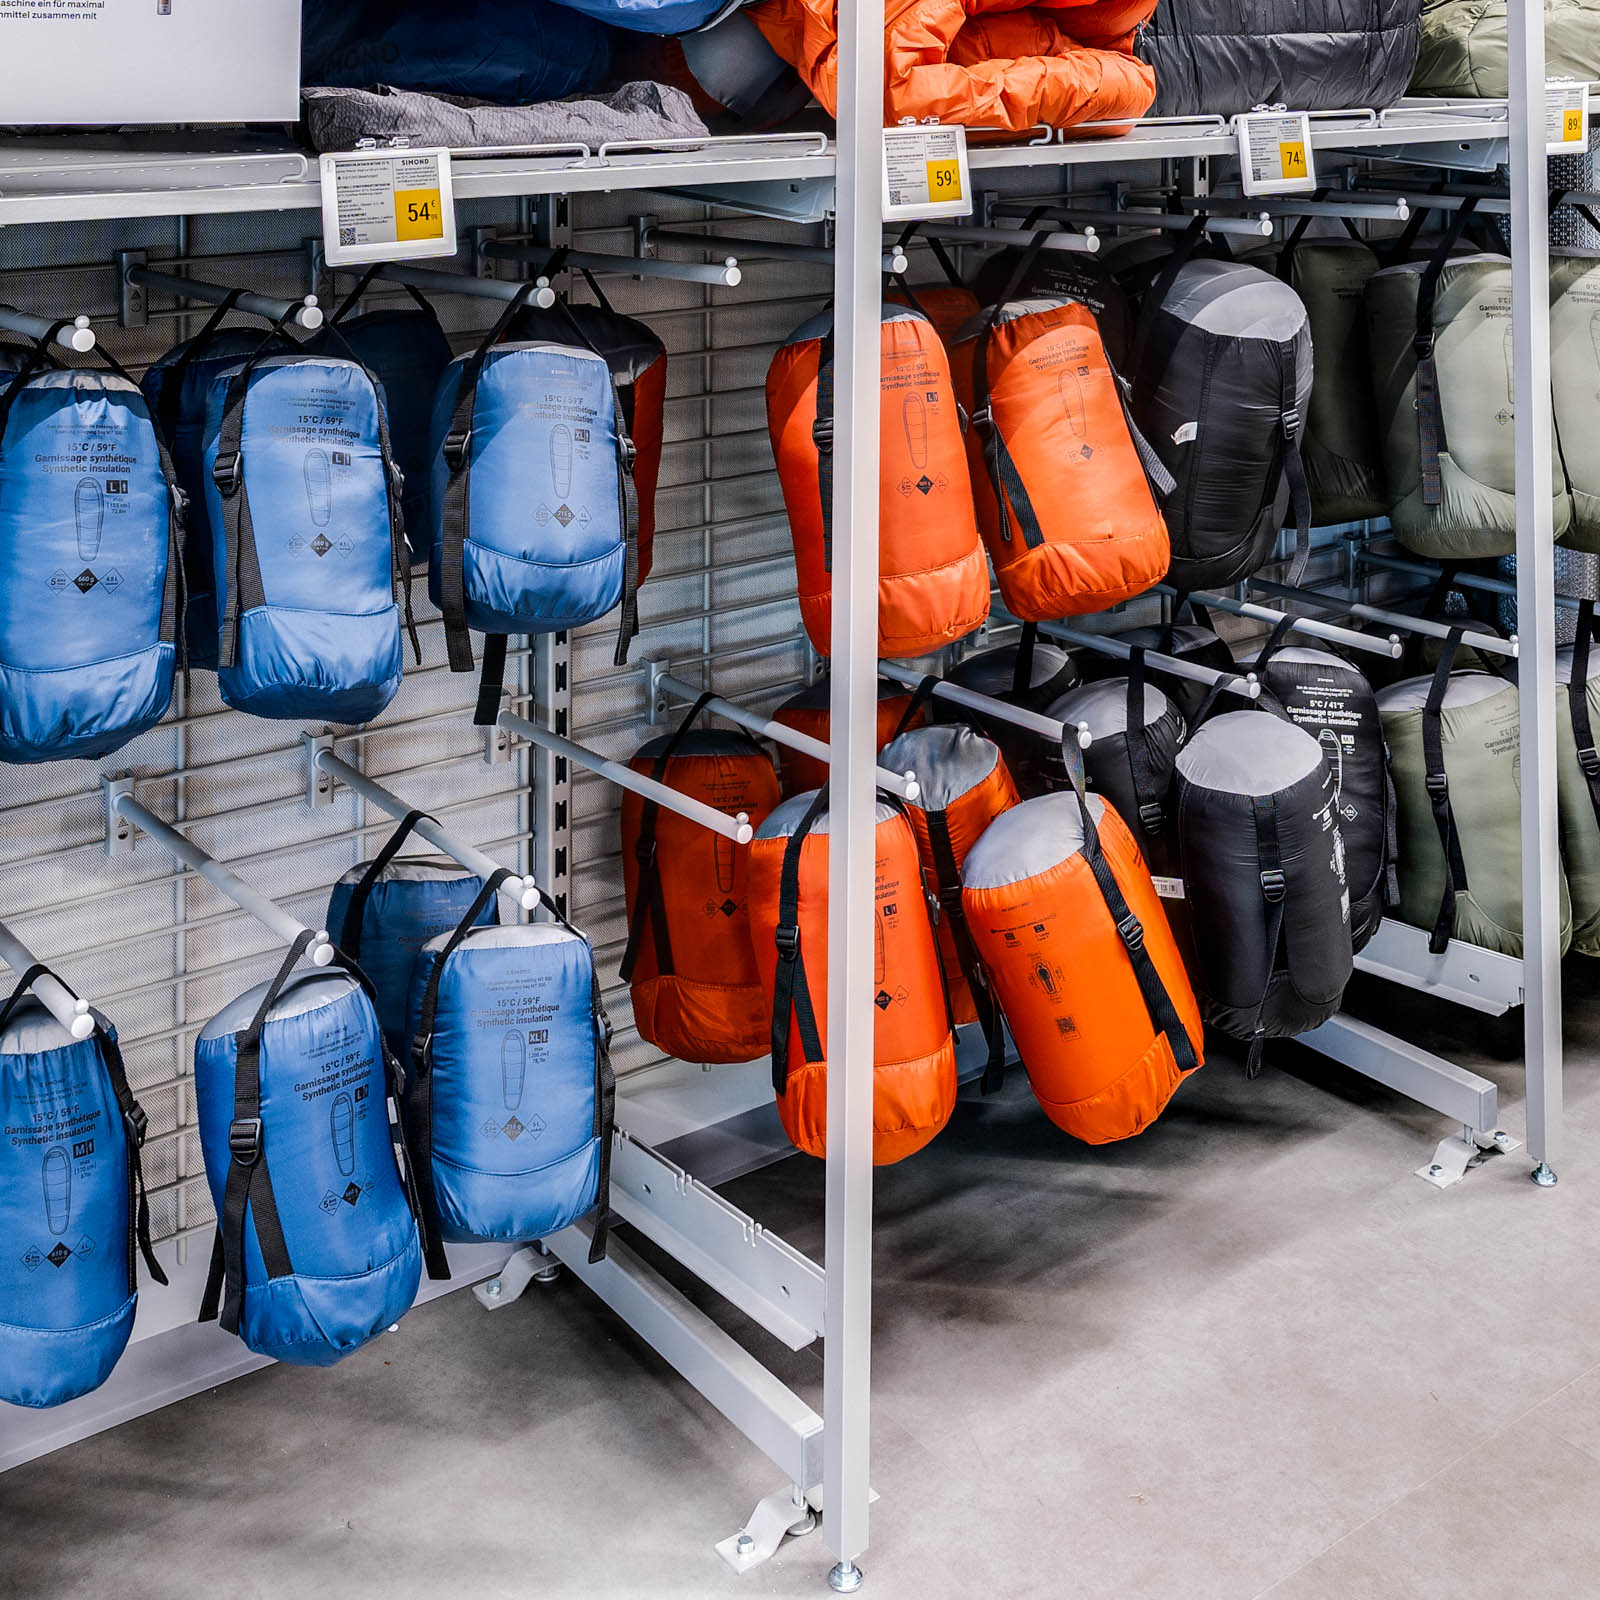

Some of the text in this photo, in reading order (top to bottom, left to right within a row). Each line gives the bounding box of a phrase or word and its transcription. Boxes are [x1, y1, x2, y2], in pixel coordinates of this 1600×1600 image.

[1568, 119, 1577, 130] 89
[1286, 152, 1299, 165] 74
[937, 170, 951, 186] 59
[408, 202, 430, 222] 54
[68, 442, 116, 451] 15°C / 59°F
[35, 454, 136, 464] Garnissage synthétique
[42, 464, 130, 474] Synthetic insulation
[1329, 701, 1344, 709] 41°F
[1287, 706, 1326, 716] Garnissage
[1293, 715, 1327, 723] Synthetic
[33, 1105, 80, 1123] 15°C / 59°F
[4, 1109, 101, 1135] Garnissage synthétique
[11, 1123, 96, 1146] Synthetic insulation
